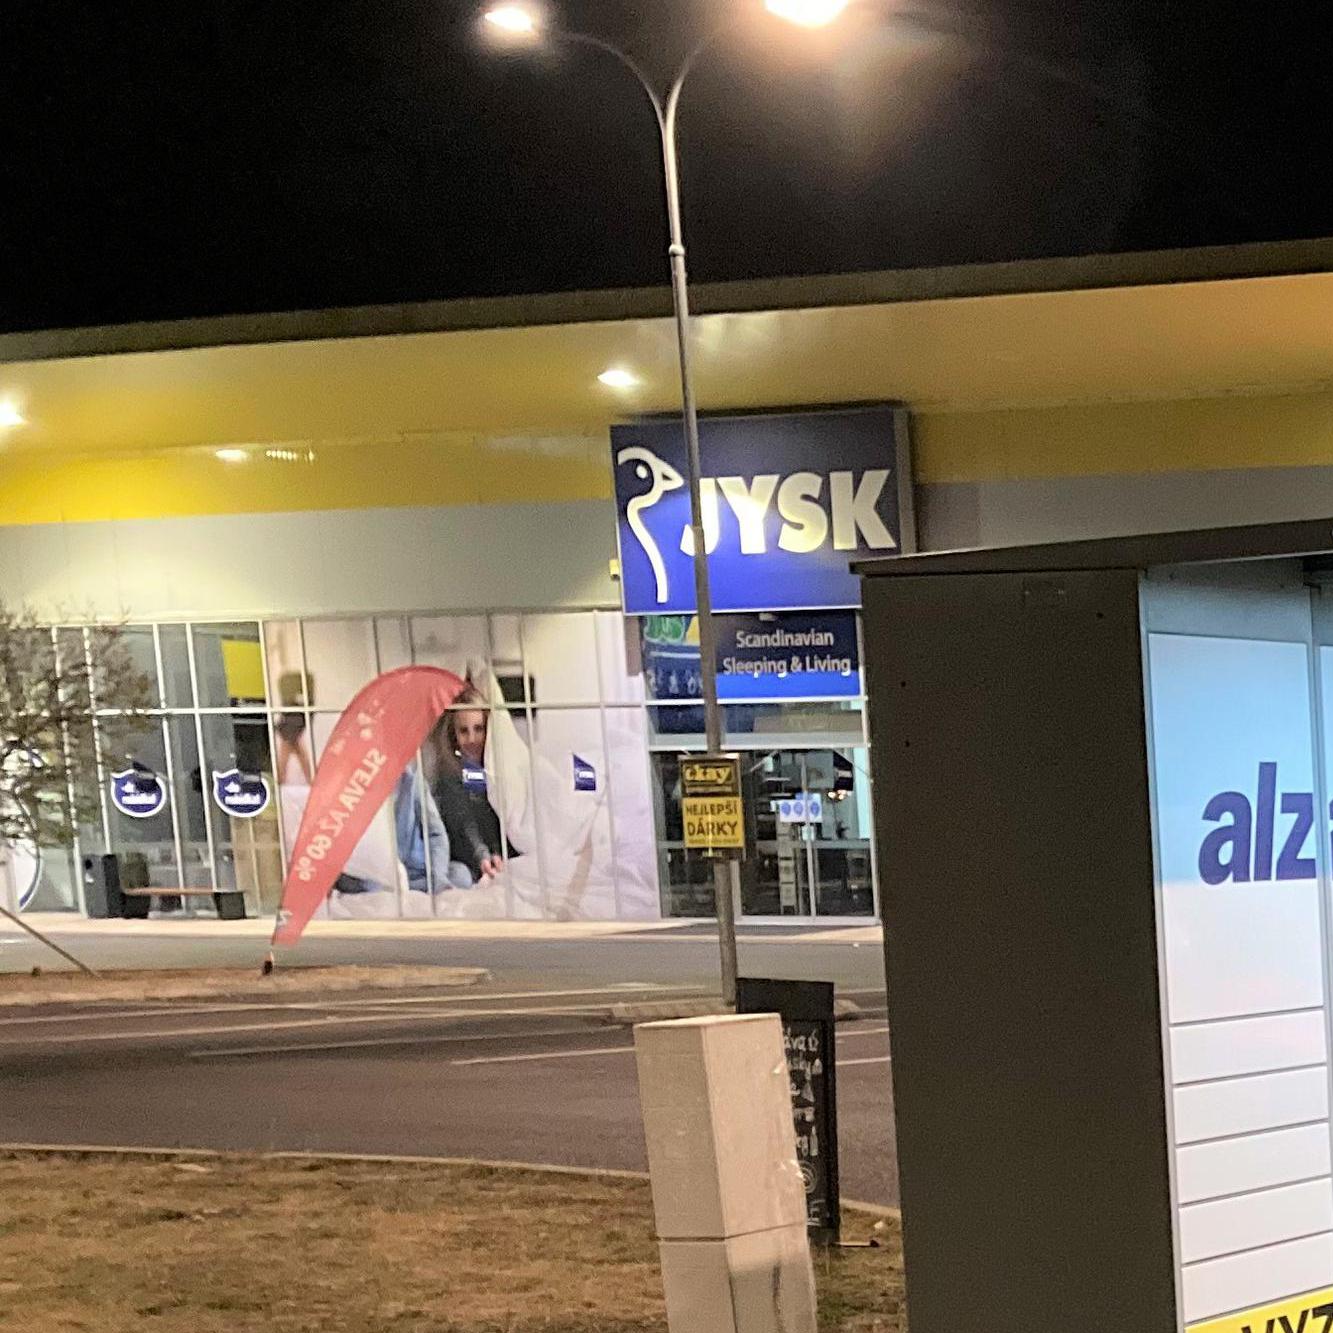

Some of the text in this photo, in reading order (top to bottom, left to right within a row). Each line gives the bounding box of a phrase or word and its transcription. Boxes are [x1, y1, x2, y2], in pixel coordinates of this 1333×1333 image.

[680, 469, 897, 556] JYSK
[735, 628, 834, 648] Scandinavian
[722, 655, 851, 679] Sleeping & Living
[687, 816, 738, 836] DÁRKY
